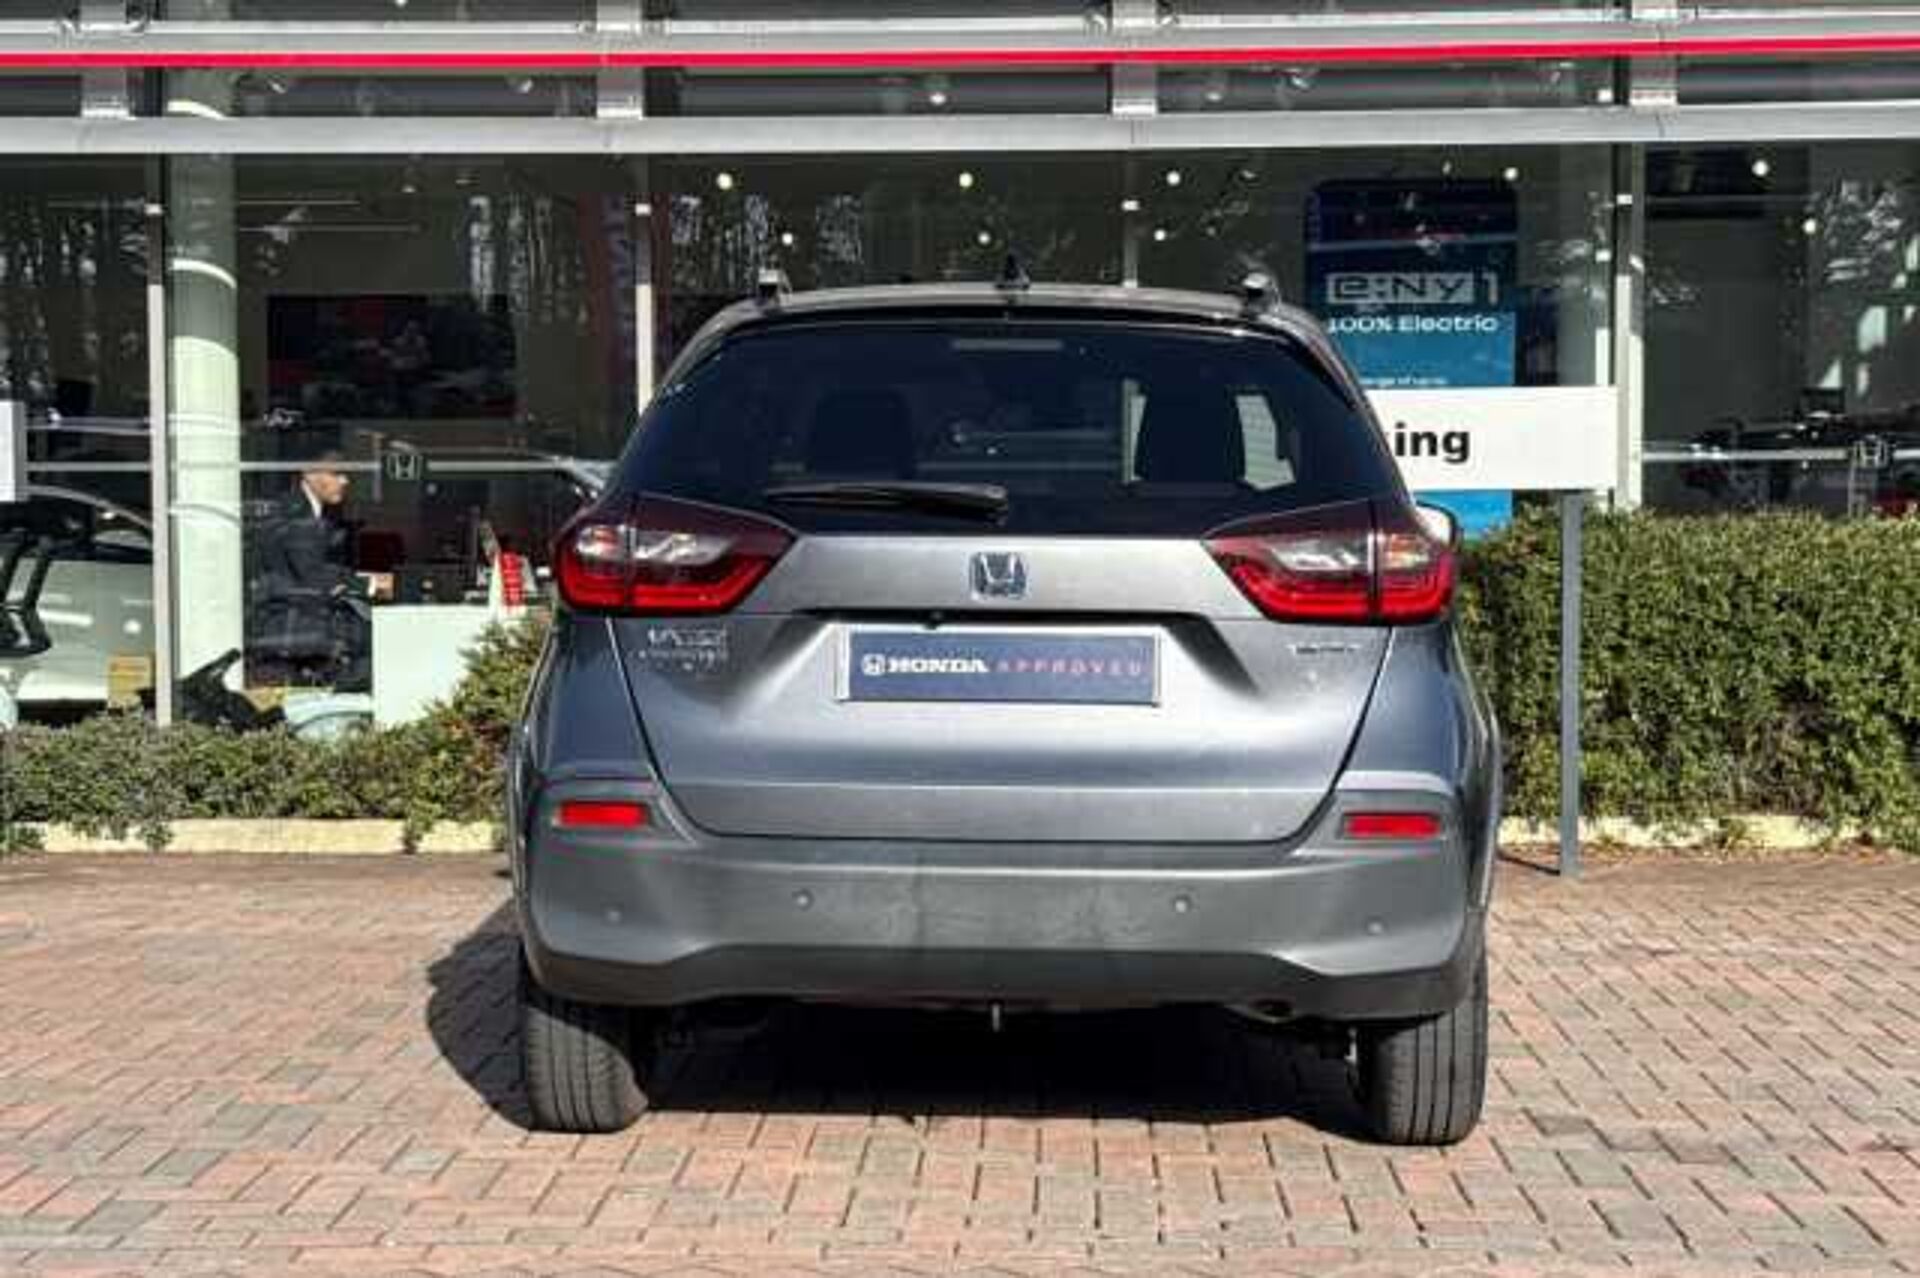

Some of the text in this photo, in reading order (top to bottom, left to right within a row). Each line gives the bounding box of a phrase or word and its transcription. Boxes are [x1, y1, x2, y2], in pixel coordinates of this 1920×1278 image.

[1400, 314, 1499, 333] Electric
[888, 658, 1142, 676] HONDA APPROVED
